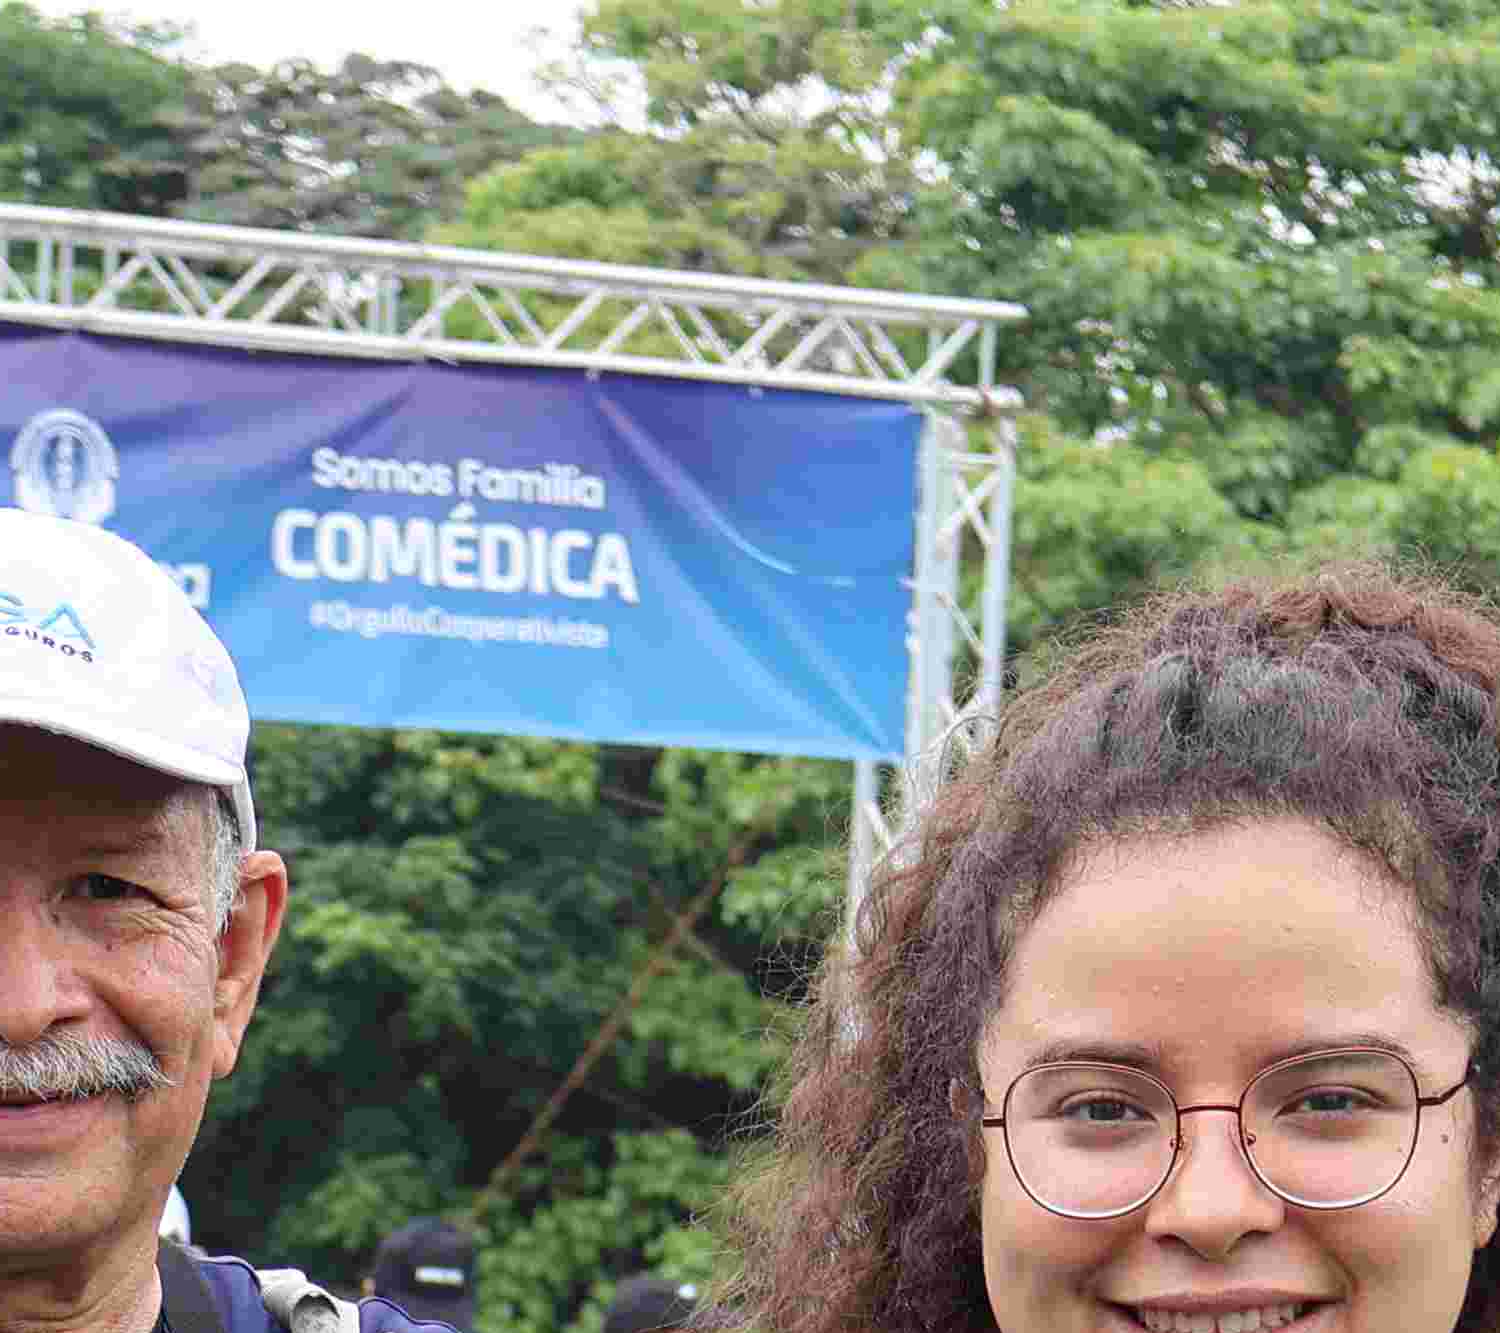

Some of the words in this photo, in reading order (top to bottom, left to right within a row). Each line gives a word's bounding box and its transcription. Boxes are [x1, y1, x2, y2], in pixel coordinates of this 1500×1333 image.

[311, 447, 453, 497] Somos
[457, 458, 606, 510] Familia
[271, 502, 640, 606] COMÉDICA
